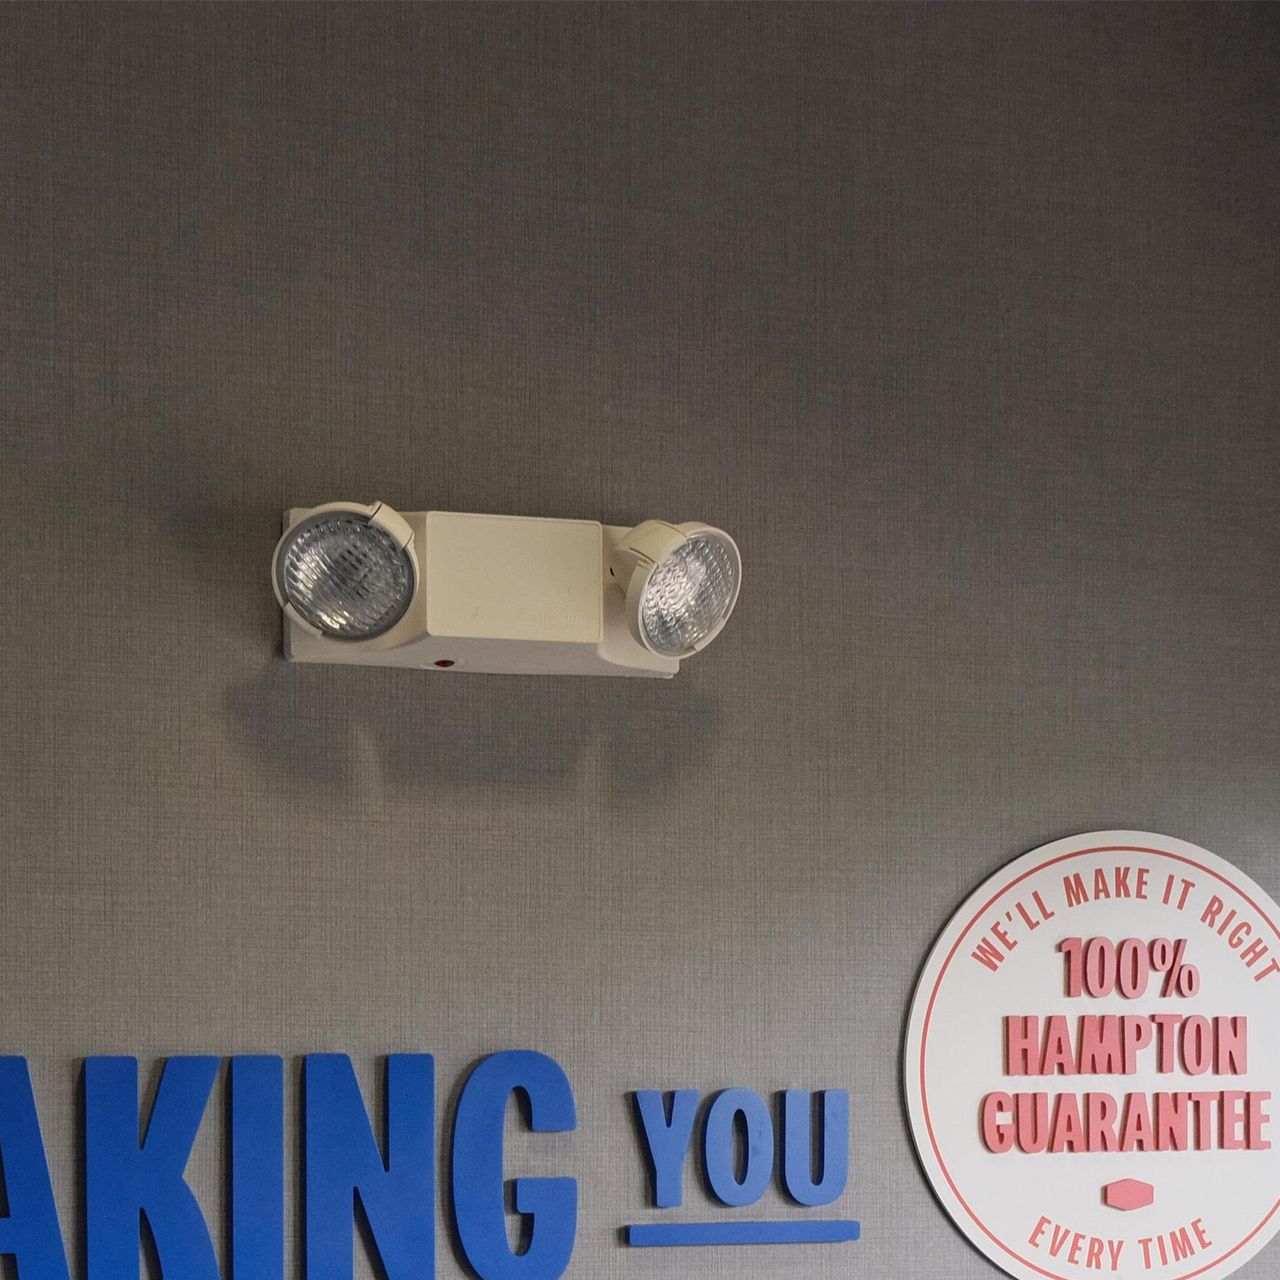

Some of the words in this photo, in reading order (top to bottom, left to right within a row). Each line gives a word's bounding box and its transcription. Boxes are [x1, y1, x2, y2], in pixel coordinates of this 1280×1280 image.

[971, 890, 1056, 973] WE'LL
[1063, 865, 1150, 909] MAKE
[1162, 873, 1197, 912] IT
[1200, 895, 1280, 983] RIGHT
[1056, 936, 1200, 1000] 100%
[1002, 1013, 1248, 1077] HAMPTON
[632, 1087, 849, 1209] YOU
[979, 1089, 1272, 1155] GUARANTEE
[1027, 1215, 1125, 1273] EVERY
[1136, 1217, 1212, 1270] TIME
